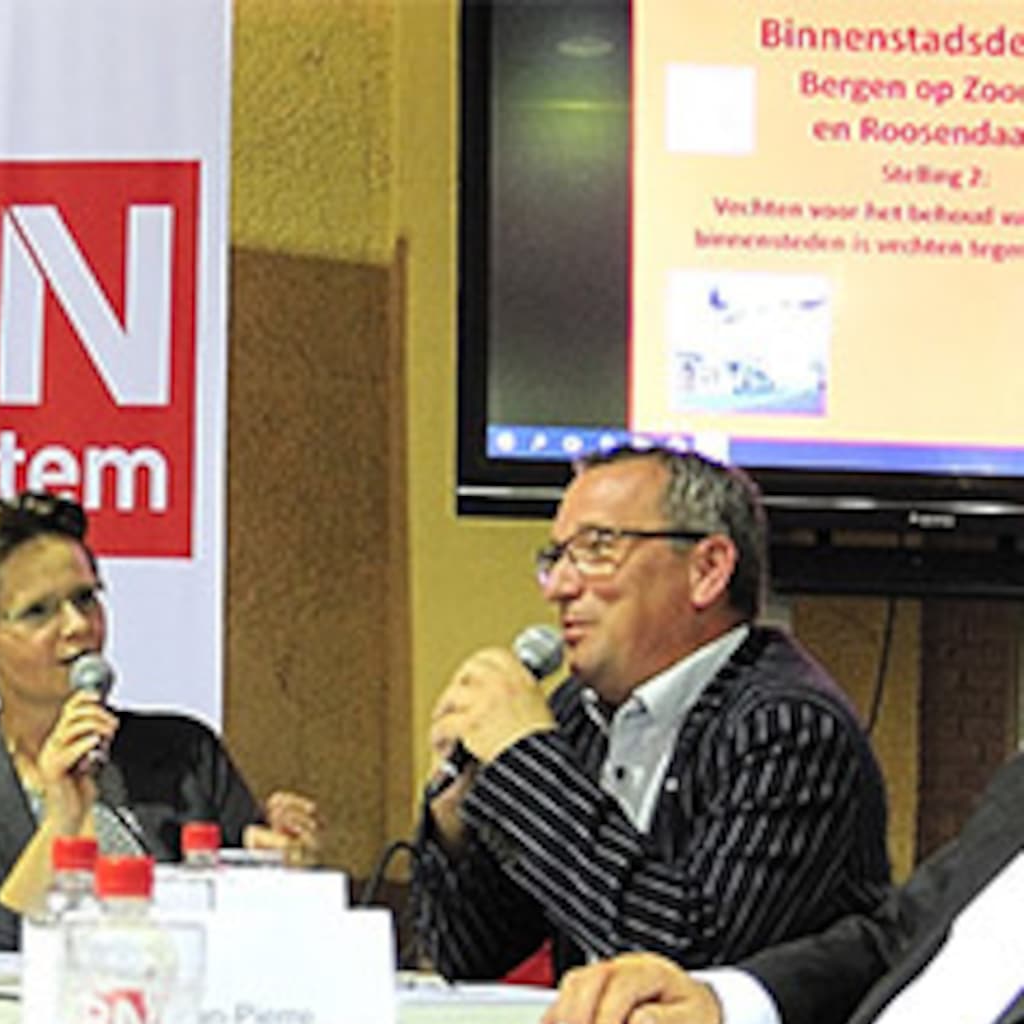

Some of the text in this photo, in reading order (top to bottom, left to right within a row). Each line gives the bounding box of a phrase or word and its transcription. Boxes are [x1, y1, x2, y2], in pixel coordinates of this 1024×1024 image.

[760, 18, 1024, 56] Binnenstadsde
[799, 70, 1024, 107] Bergen op Zoo
[812, 121, 850, 142] en
